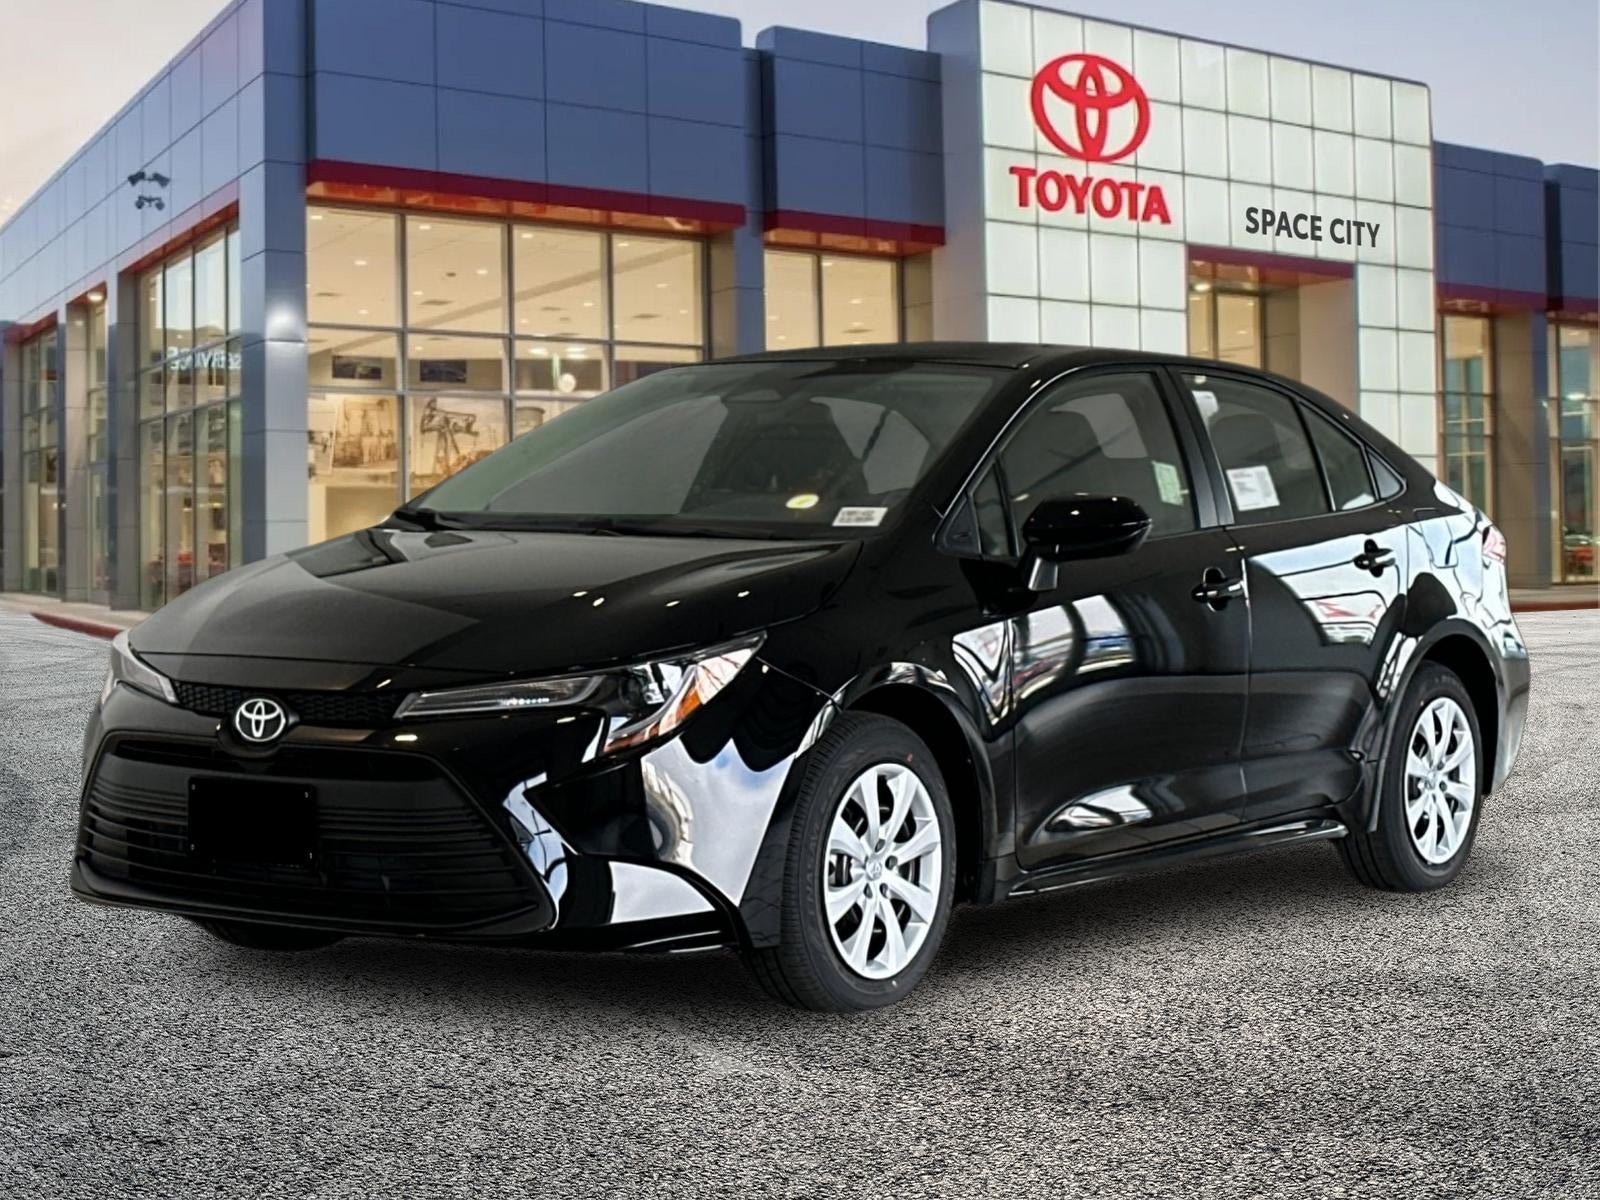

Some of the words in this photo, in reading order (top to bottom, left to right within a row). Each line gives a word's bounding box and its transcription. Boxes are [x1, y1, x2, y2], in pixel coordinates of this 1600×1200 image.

[1009, 166, 1171, 224] TOYOTA
[1245, 207, 1322, 242] SPACE
[1329, 218, 1380, 248] CITY
